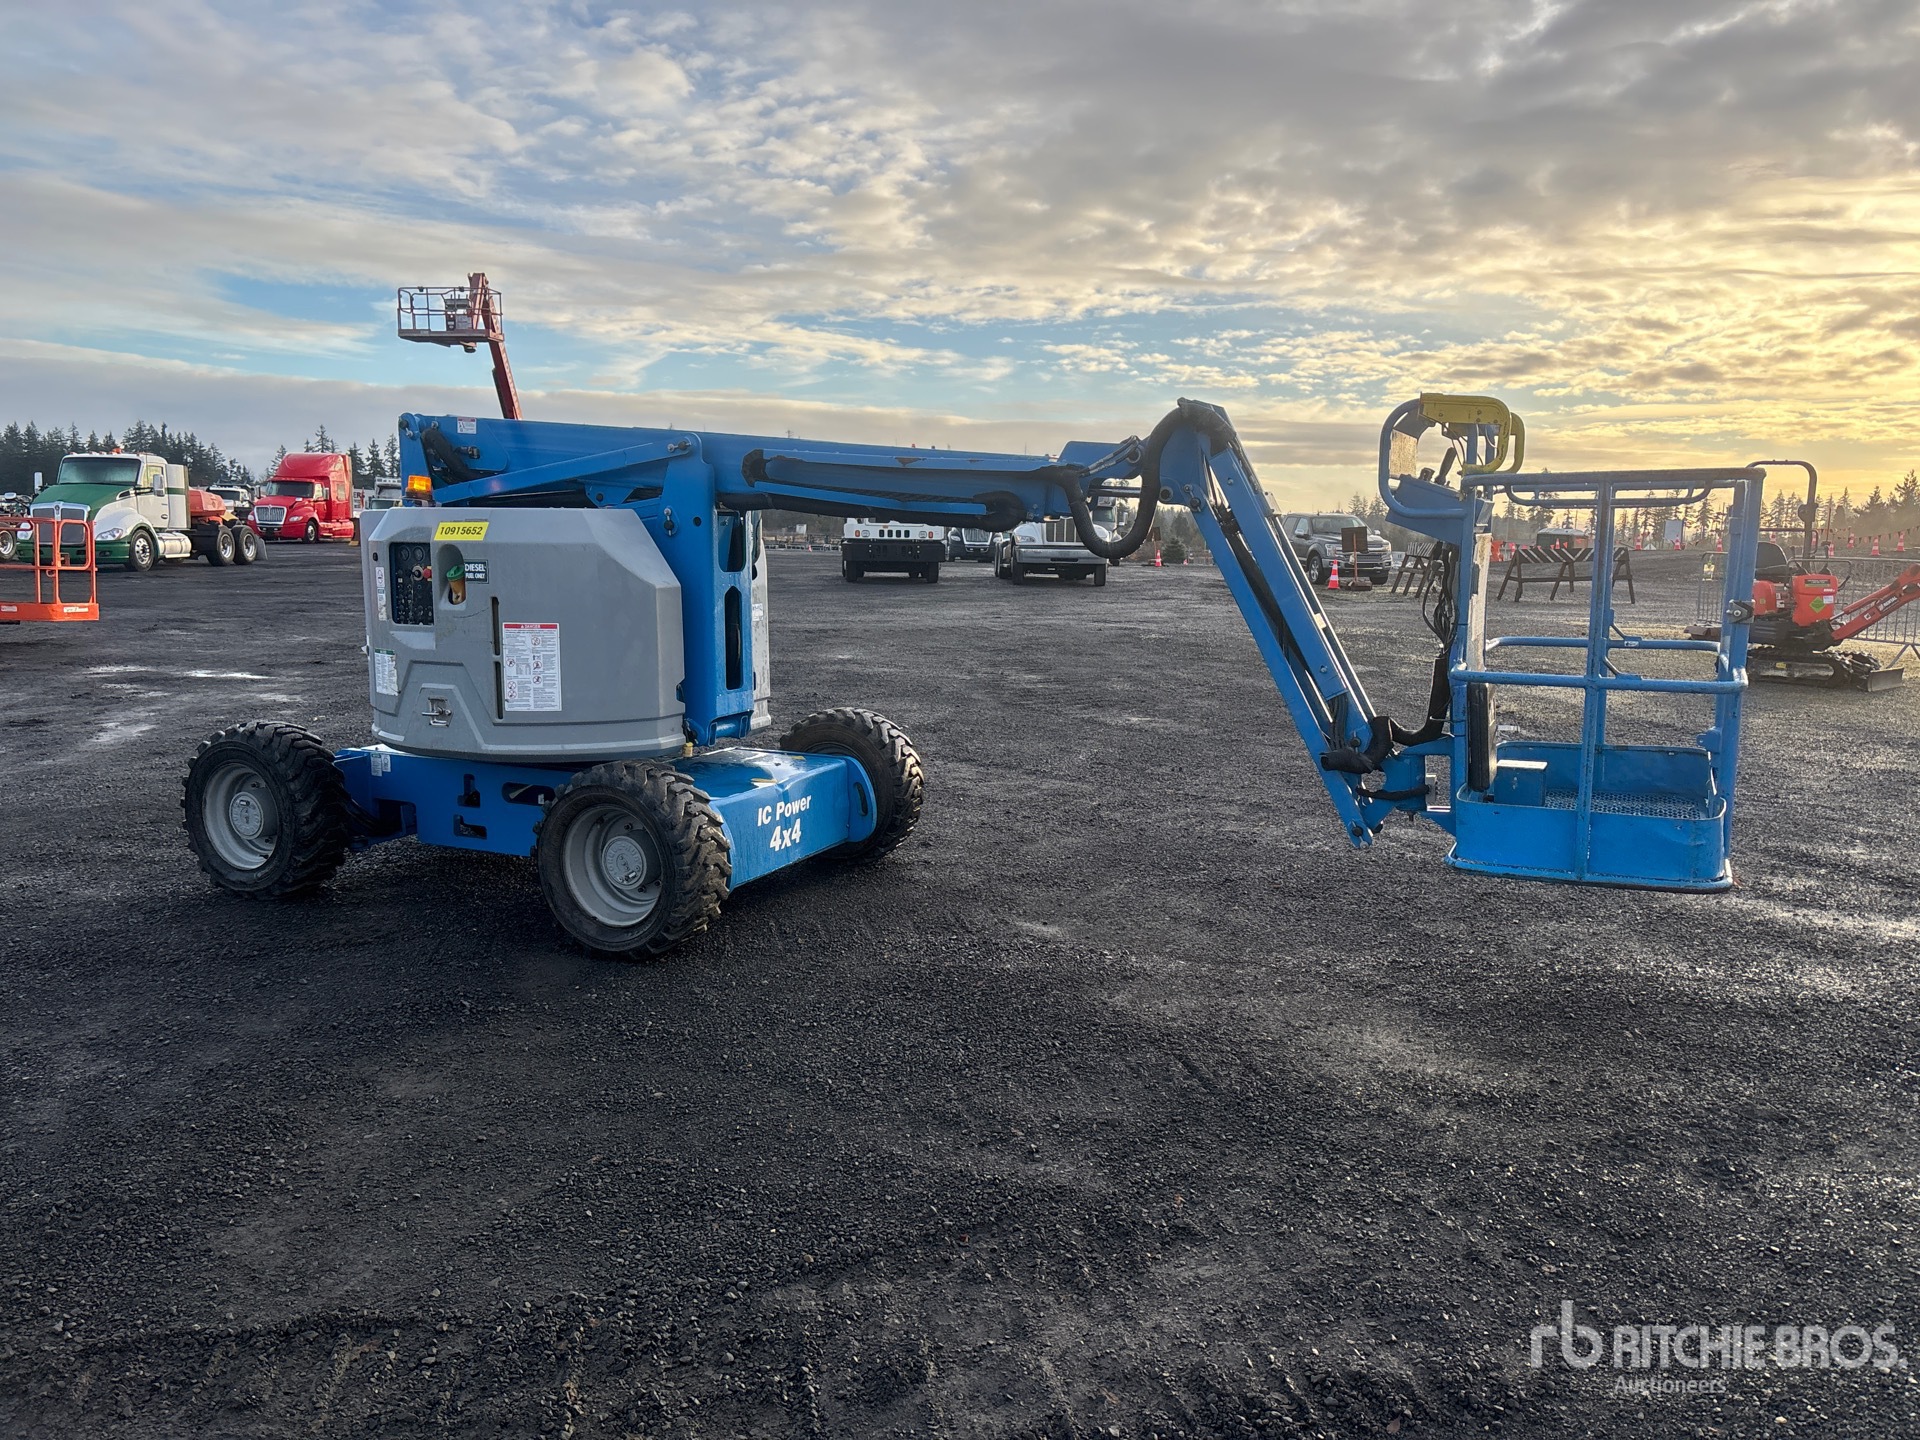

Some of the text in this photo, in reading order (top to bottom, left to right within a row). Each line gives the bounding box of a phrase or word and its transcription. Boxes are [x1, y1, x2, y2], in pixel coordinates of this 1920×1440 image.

[440, 526, 483, 535] 10915652
[464, 563, 486, 572] DIESEL
[757, 794, 812, 827] IC Power
[770, 817, 802, 852] 4x4
